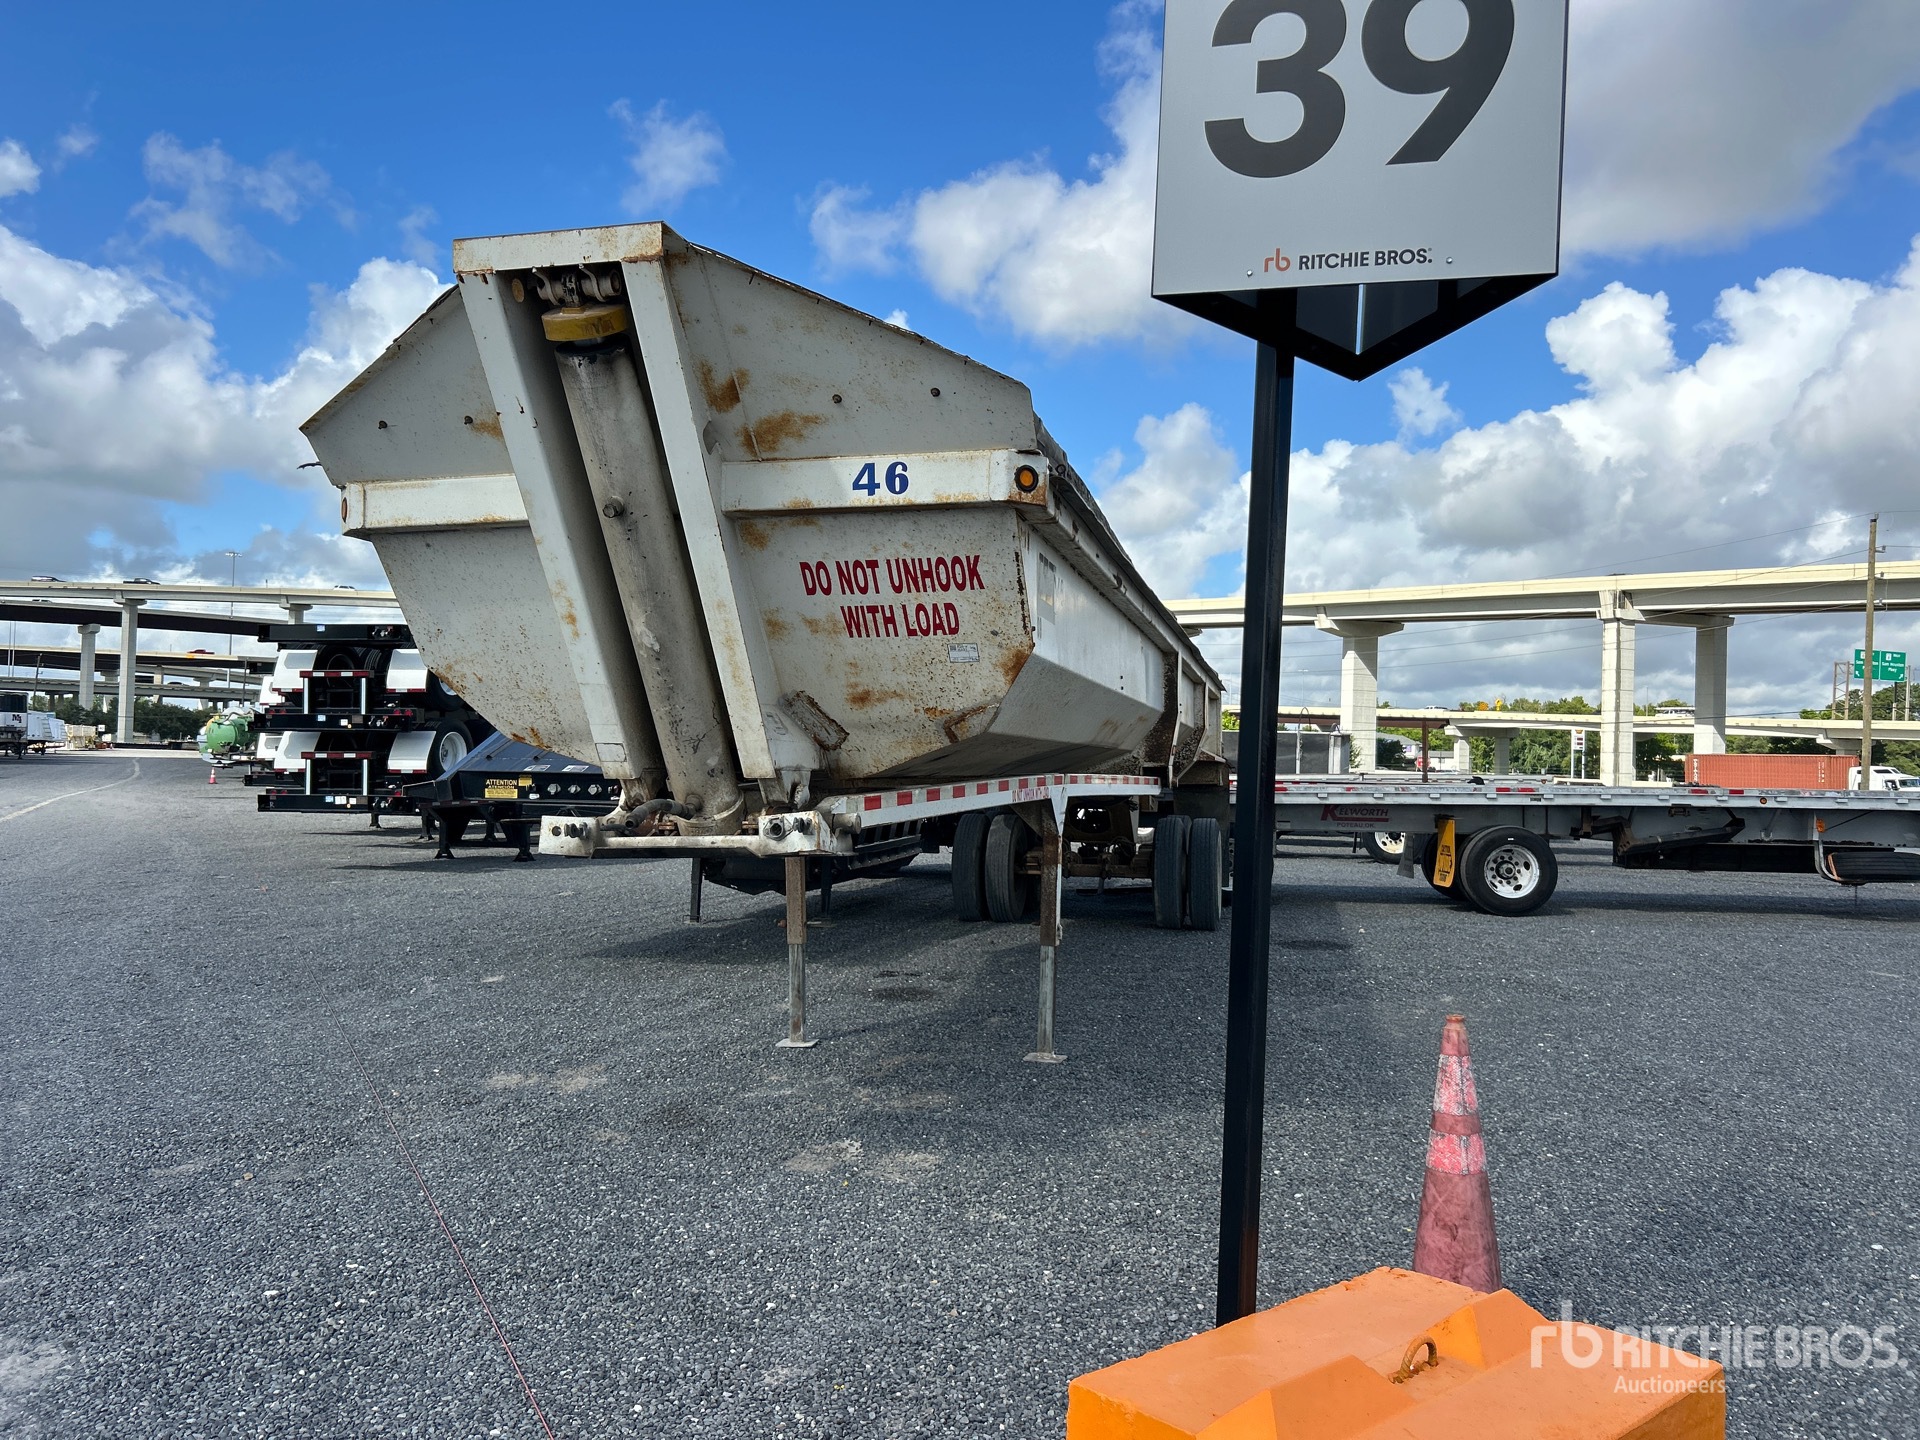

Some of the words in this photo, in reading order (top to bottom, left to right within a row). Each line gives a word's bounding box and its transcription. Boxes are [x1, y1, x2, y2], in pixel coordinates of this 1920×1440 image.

[1204, 0, 1515, 178] 39
[1299, 251, 1370, 270] RITCHIE
[1374, 248, 1433, 266] BROS.
[852, 461, 910, 496] 46
[800, 560, 832, 596] DO
[835, 559, 880, 596] NOT
[885, 554, 986, 595] UNHOOK
[840, 603, 899, 638] WITH
[901, 602, 960, 637] LOAD
[1320, 804, 1390, 822] KELWORTH
